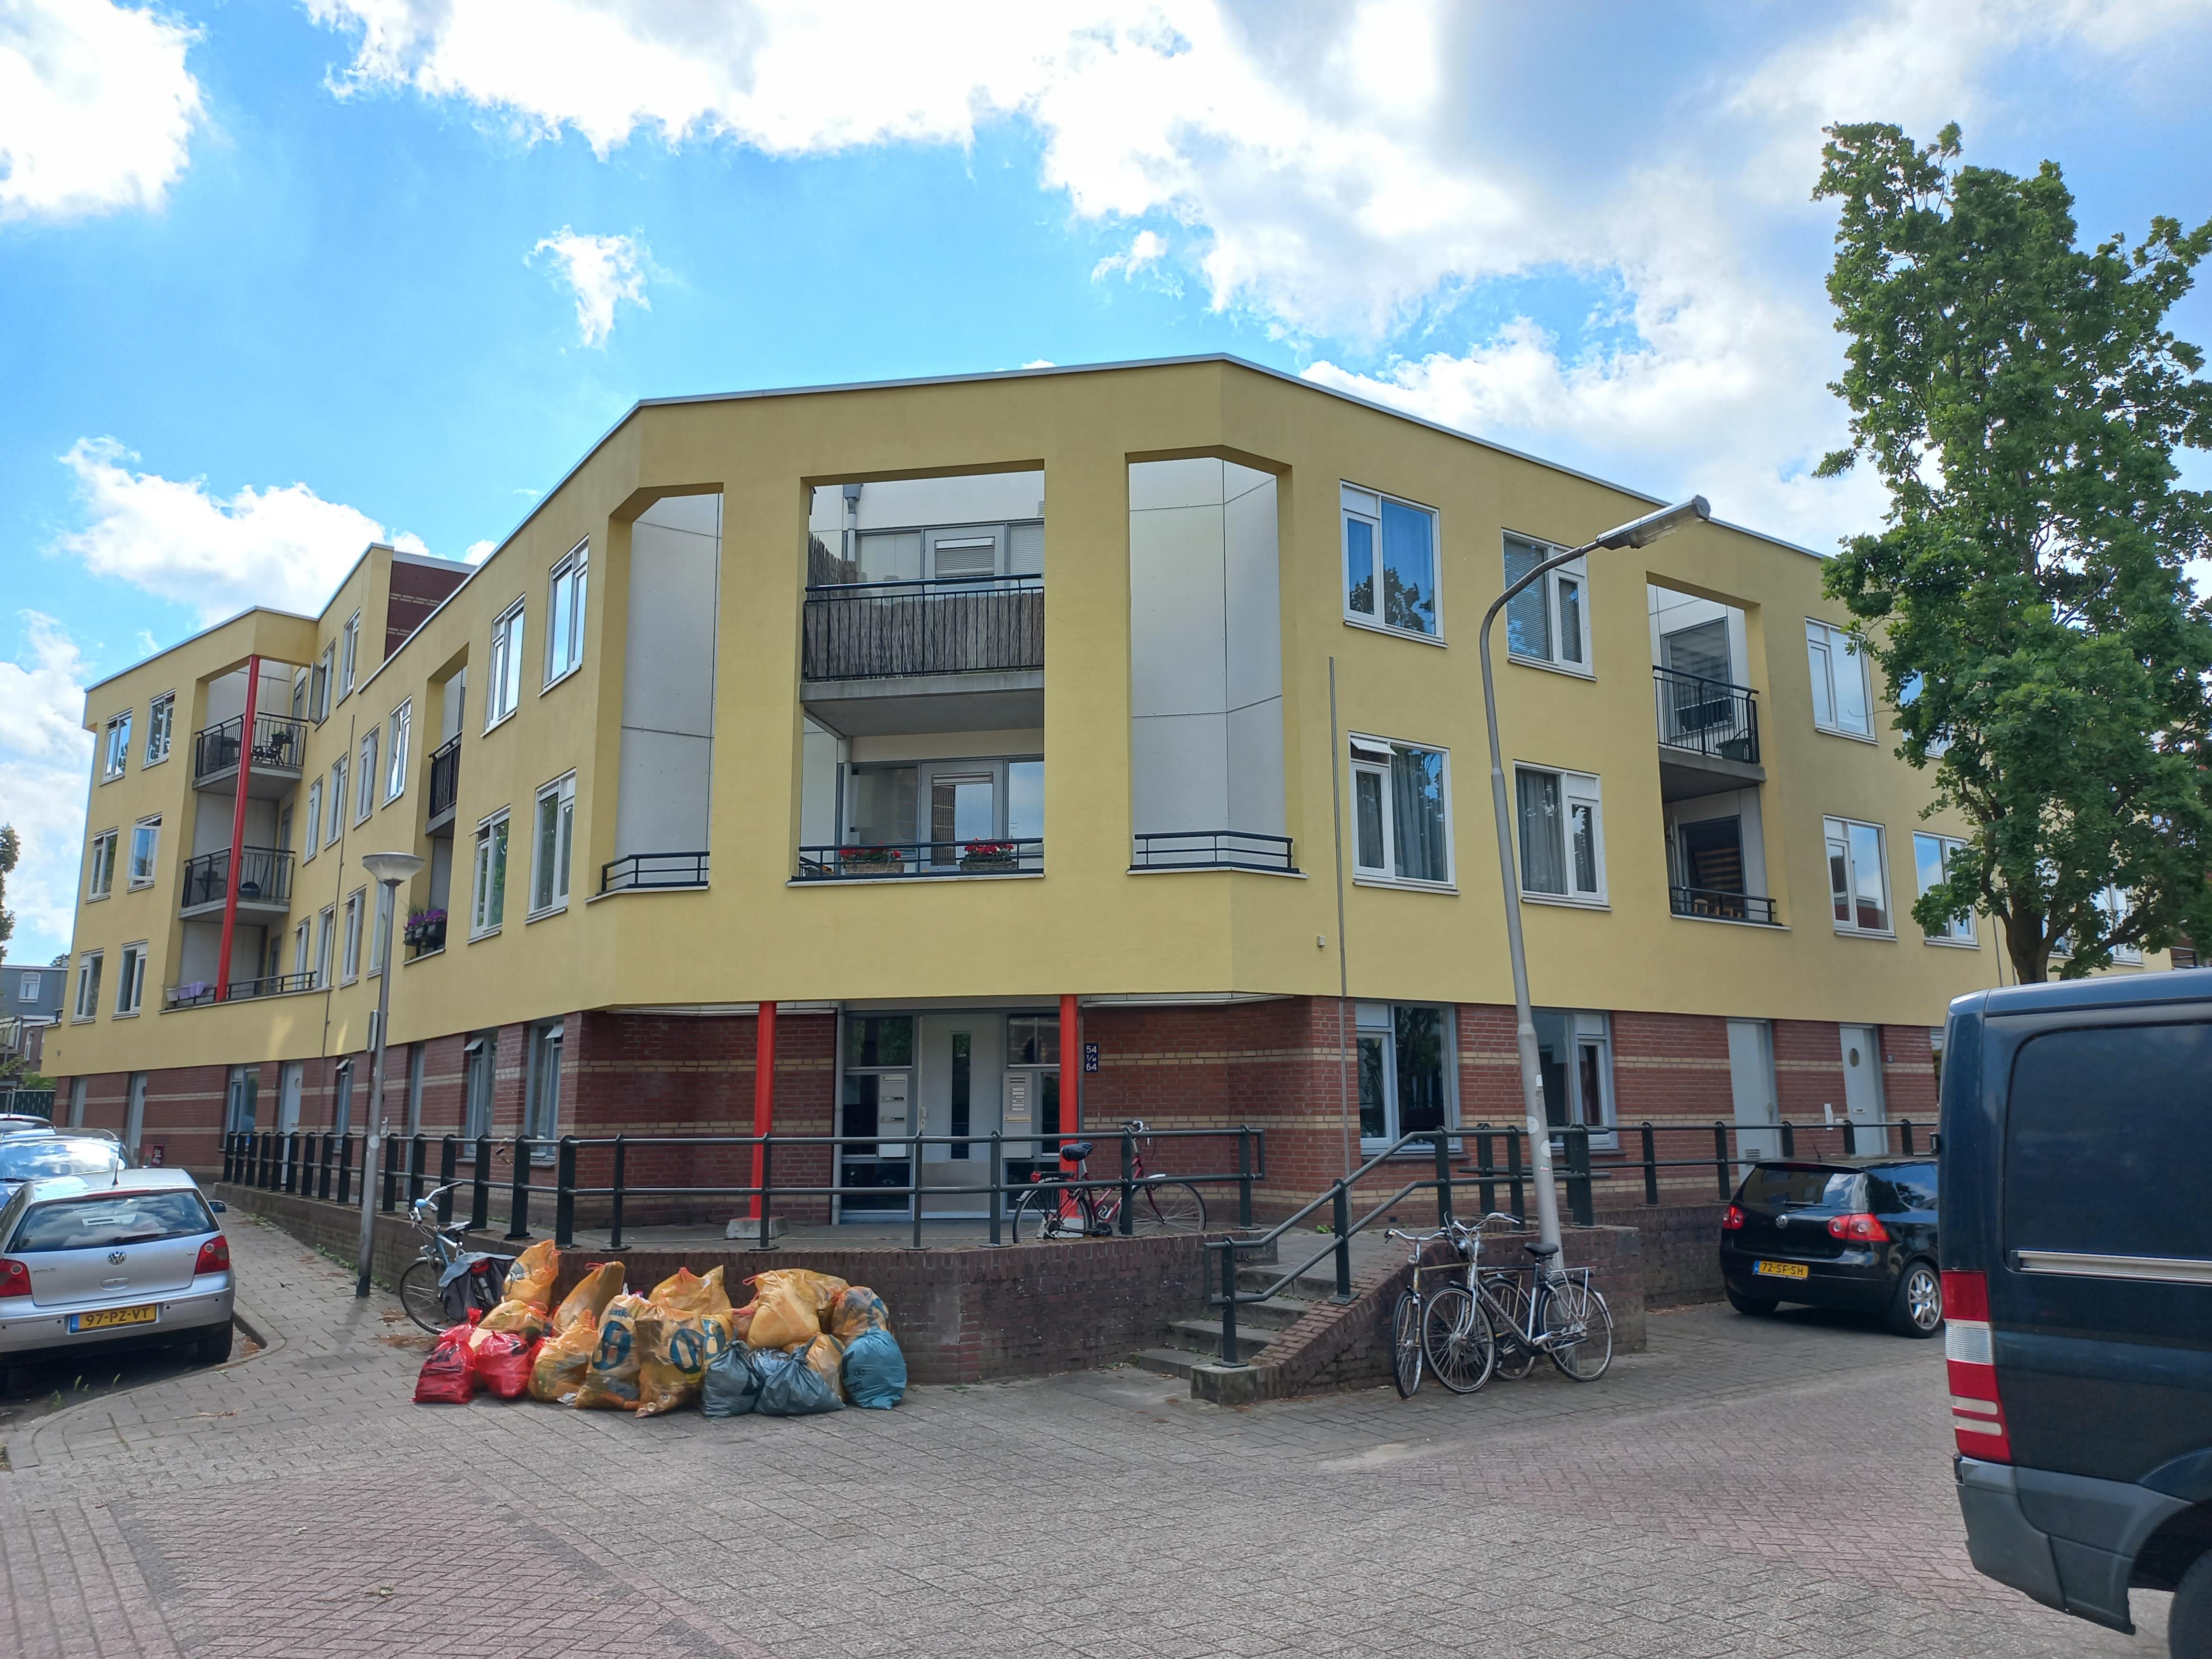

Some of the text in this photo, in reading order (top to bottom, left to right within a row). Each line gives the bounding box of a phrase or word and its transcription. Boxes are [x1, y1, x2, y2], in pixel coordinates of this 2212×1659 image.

[1086, 1045, 1097, 1053] 54
[1086, 1063, 1097, 1071] 64
[1762, 1262, 1803, 1276] 72-SF-SH
[86, 1307, 149, 1326] 97-PZ-VT
